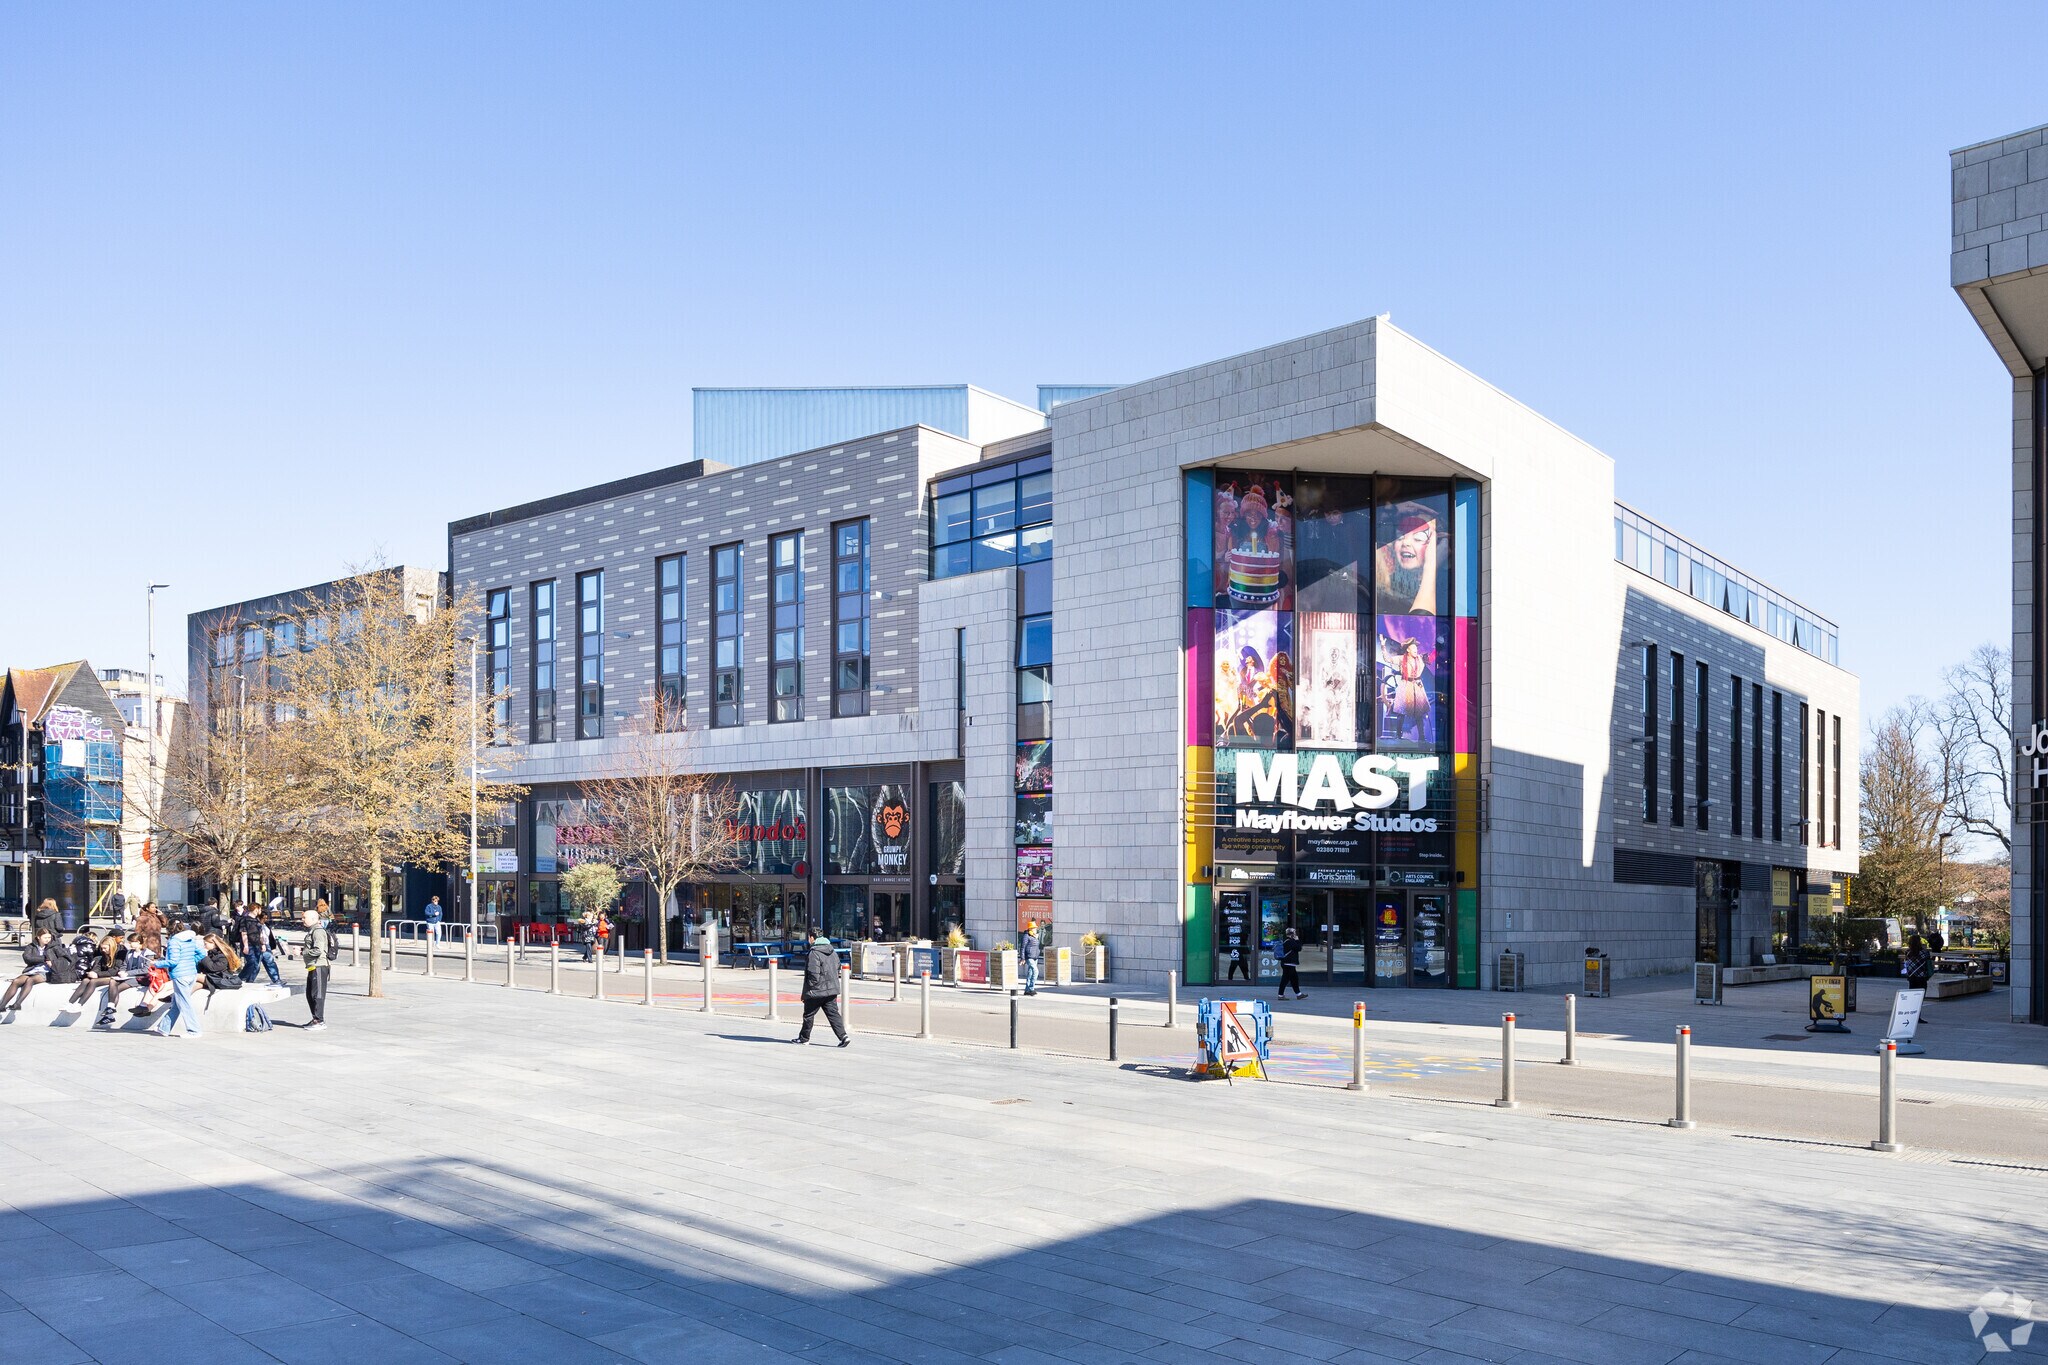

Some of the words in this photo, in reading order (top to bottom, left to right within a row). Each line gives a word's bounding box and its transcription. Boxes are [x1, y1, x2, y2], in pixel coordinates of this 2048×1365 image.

[1236, 752, 1439, 811] MAST
[725, 816, 806, 841] Nando's
[1236, 809, 1351, 833] Mayflower
[1353, 811, 1438, 833] Studios
[878, 854, 908, 866] MONKEY
